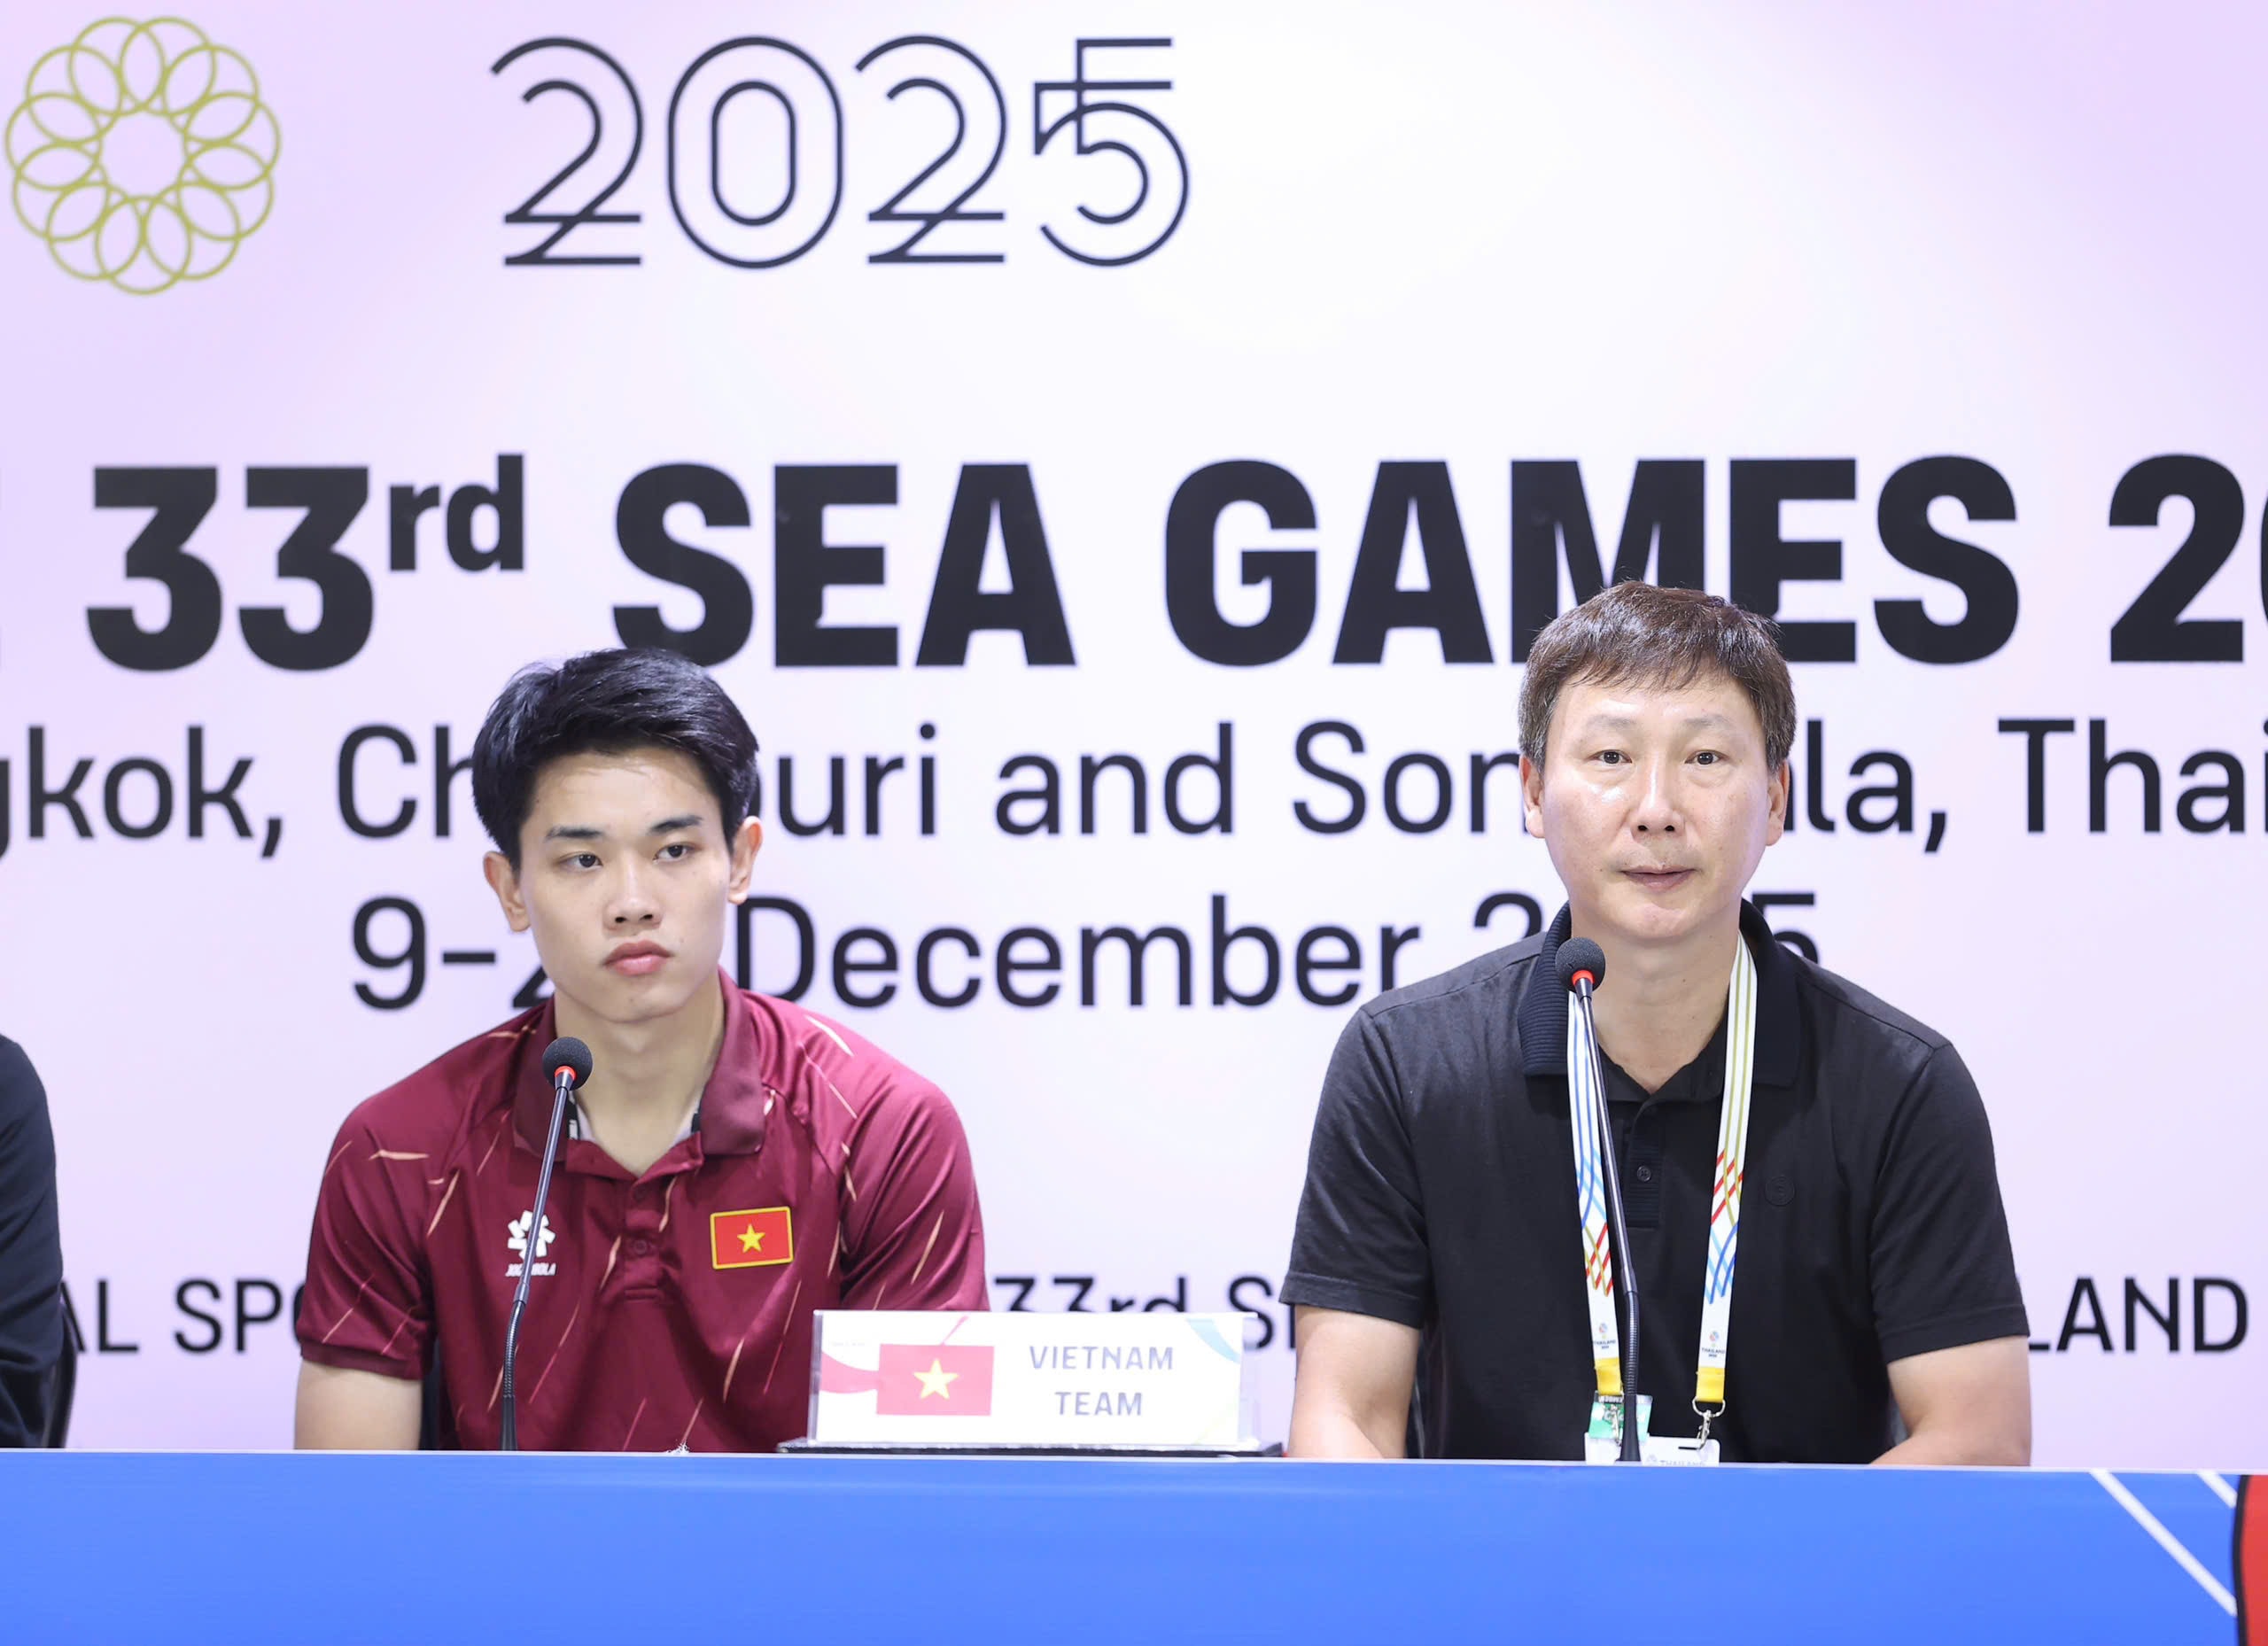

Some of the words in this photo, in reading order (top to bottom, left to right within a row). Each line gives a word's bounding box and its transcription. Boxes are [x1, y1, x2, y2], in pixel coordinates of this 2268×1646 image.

[491, 35, 1189, 268] 2025
[87, 454, 524, 672] 33rd
[613, 463, 1076, 668] SEA
[1166, 455, 2018, 666] GAMES
[2109, 454, 2268, 663] 2
[0, 725, 282, 859] kok,
[996, 723, 1233, 836] and
[737, 894, 1420, 1009] December
[1029, 1346, 1174, 1370] VIETNAM
[1054, 1391, 1143, 1417] TEAM
